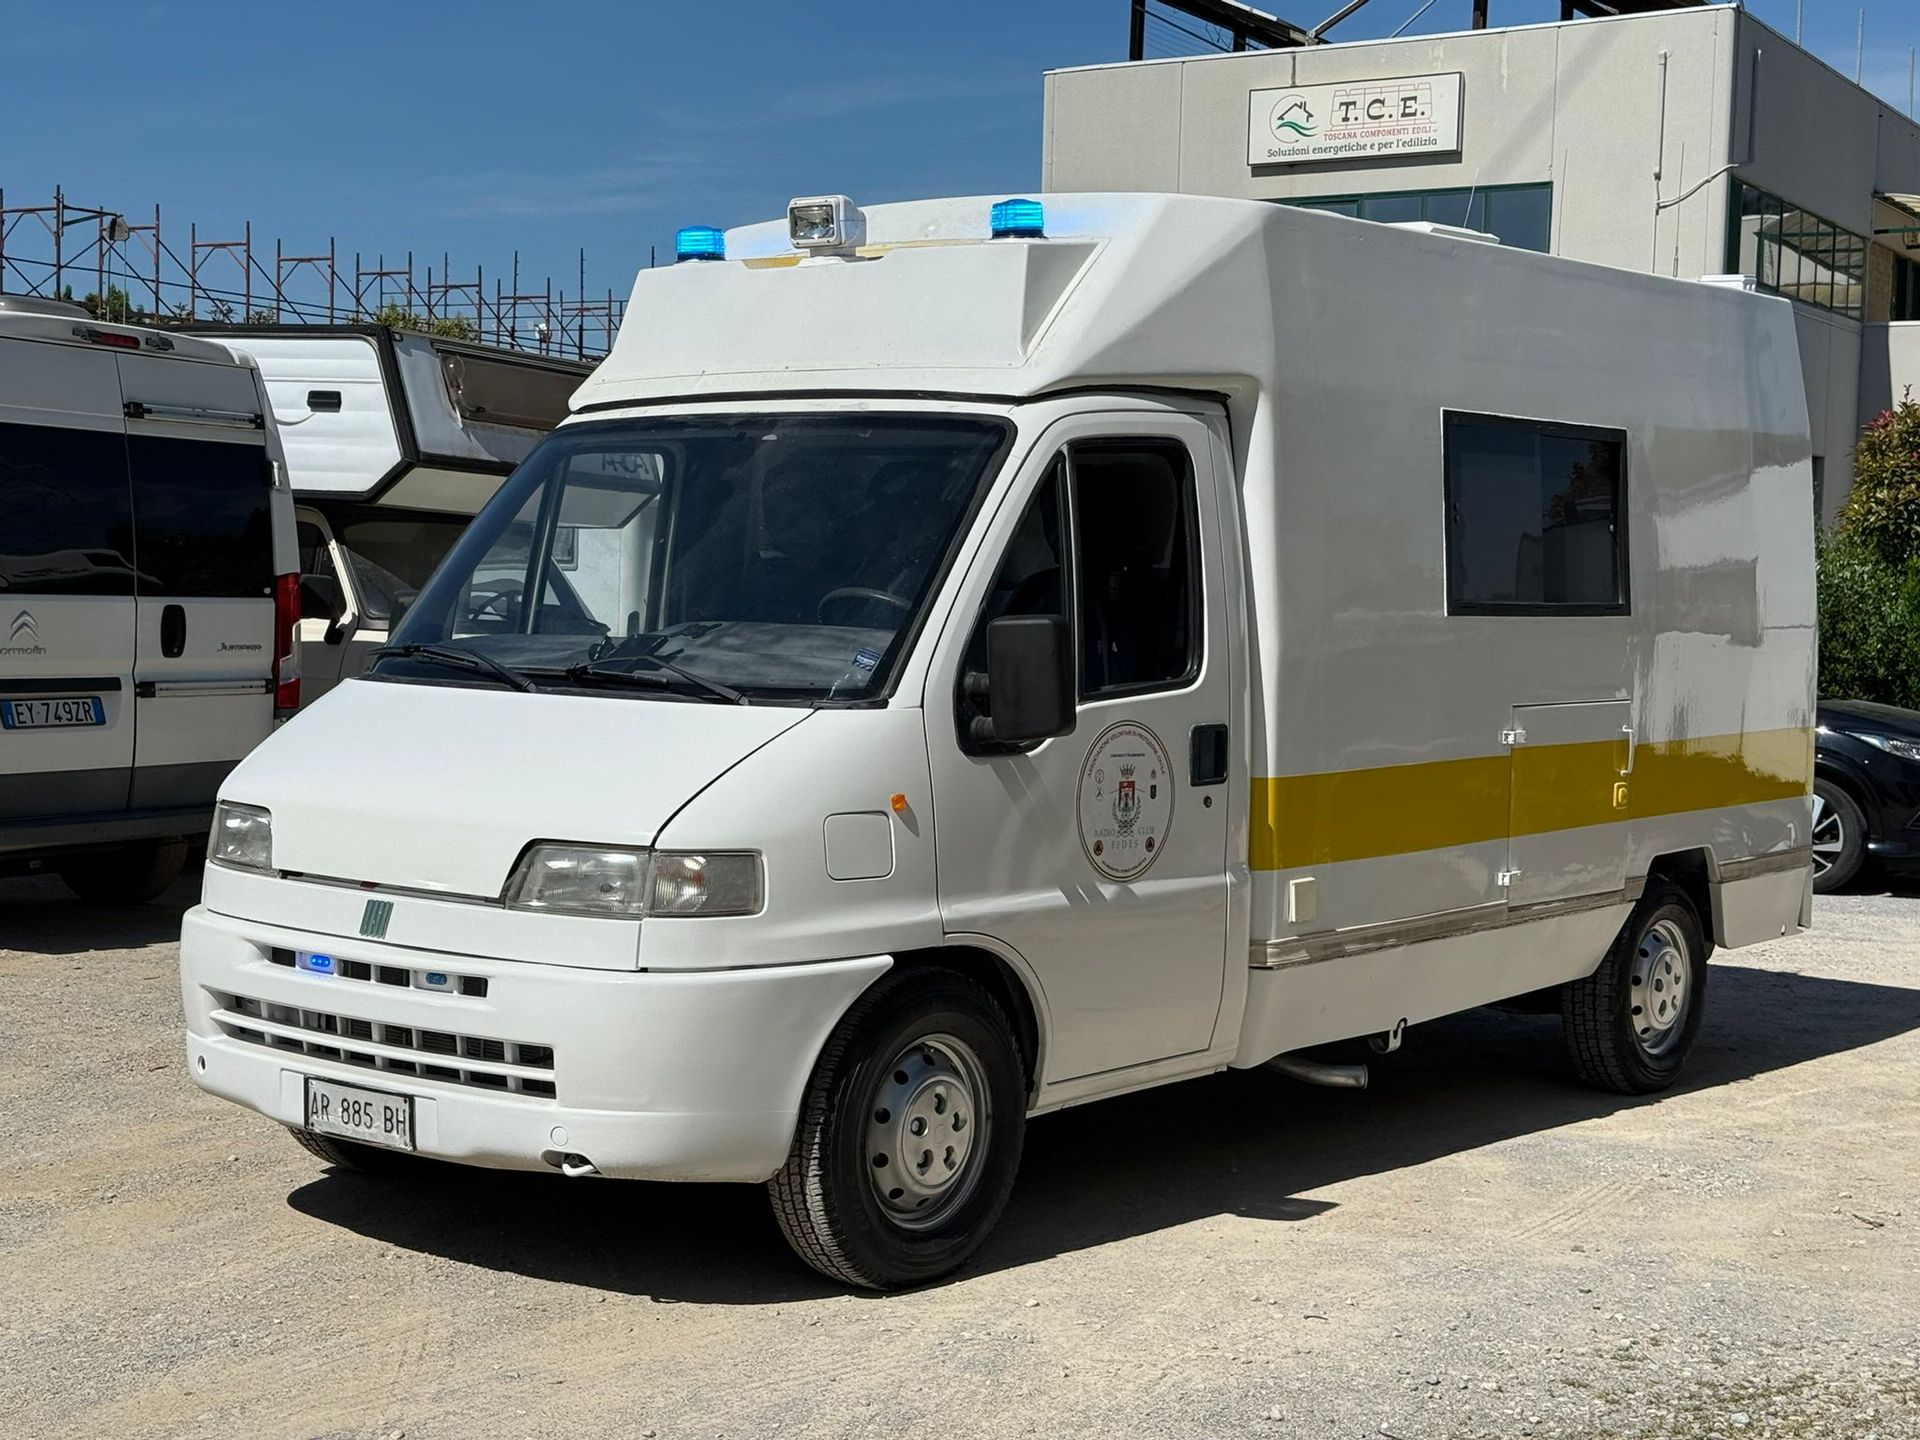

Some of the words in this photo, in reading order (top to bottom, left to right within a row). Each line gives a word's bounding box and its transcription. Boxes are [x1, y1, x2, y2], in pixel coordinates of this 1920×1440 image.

[1339, 95, 1426, 122] T.C.E.
[1267, 145, 1310, 157] Soluzioni
[1312, 141, 1368, 155] energetiche
[1378, 141, 1394, 152] per
[1397, 136, 1438, 148] l'edilizia
[1323, 130, 1358, 141] TOSCANA
[1360, 127, 1409, 138] COMPONENTI
[1412, 126, 1432, 135] EDILI
[15, 702, 35, 725] EY
[44, 699, 93, 724] 749ZR
[310, 1091, 330, 1121] AR
[341, 1097, 373, 1129] 885
[383, 1105, 406, 1136] BH
